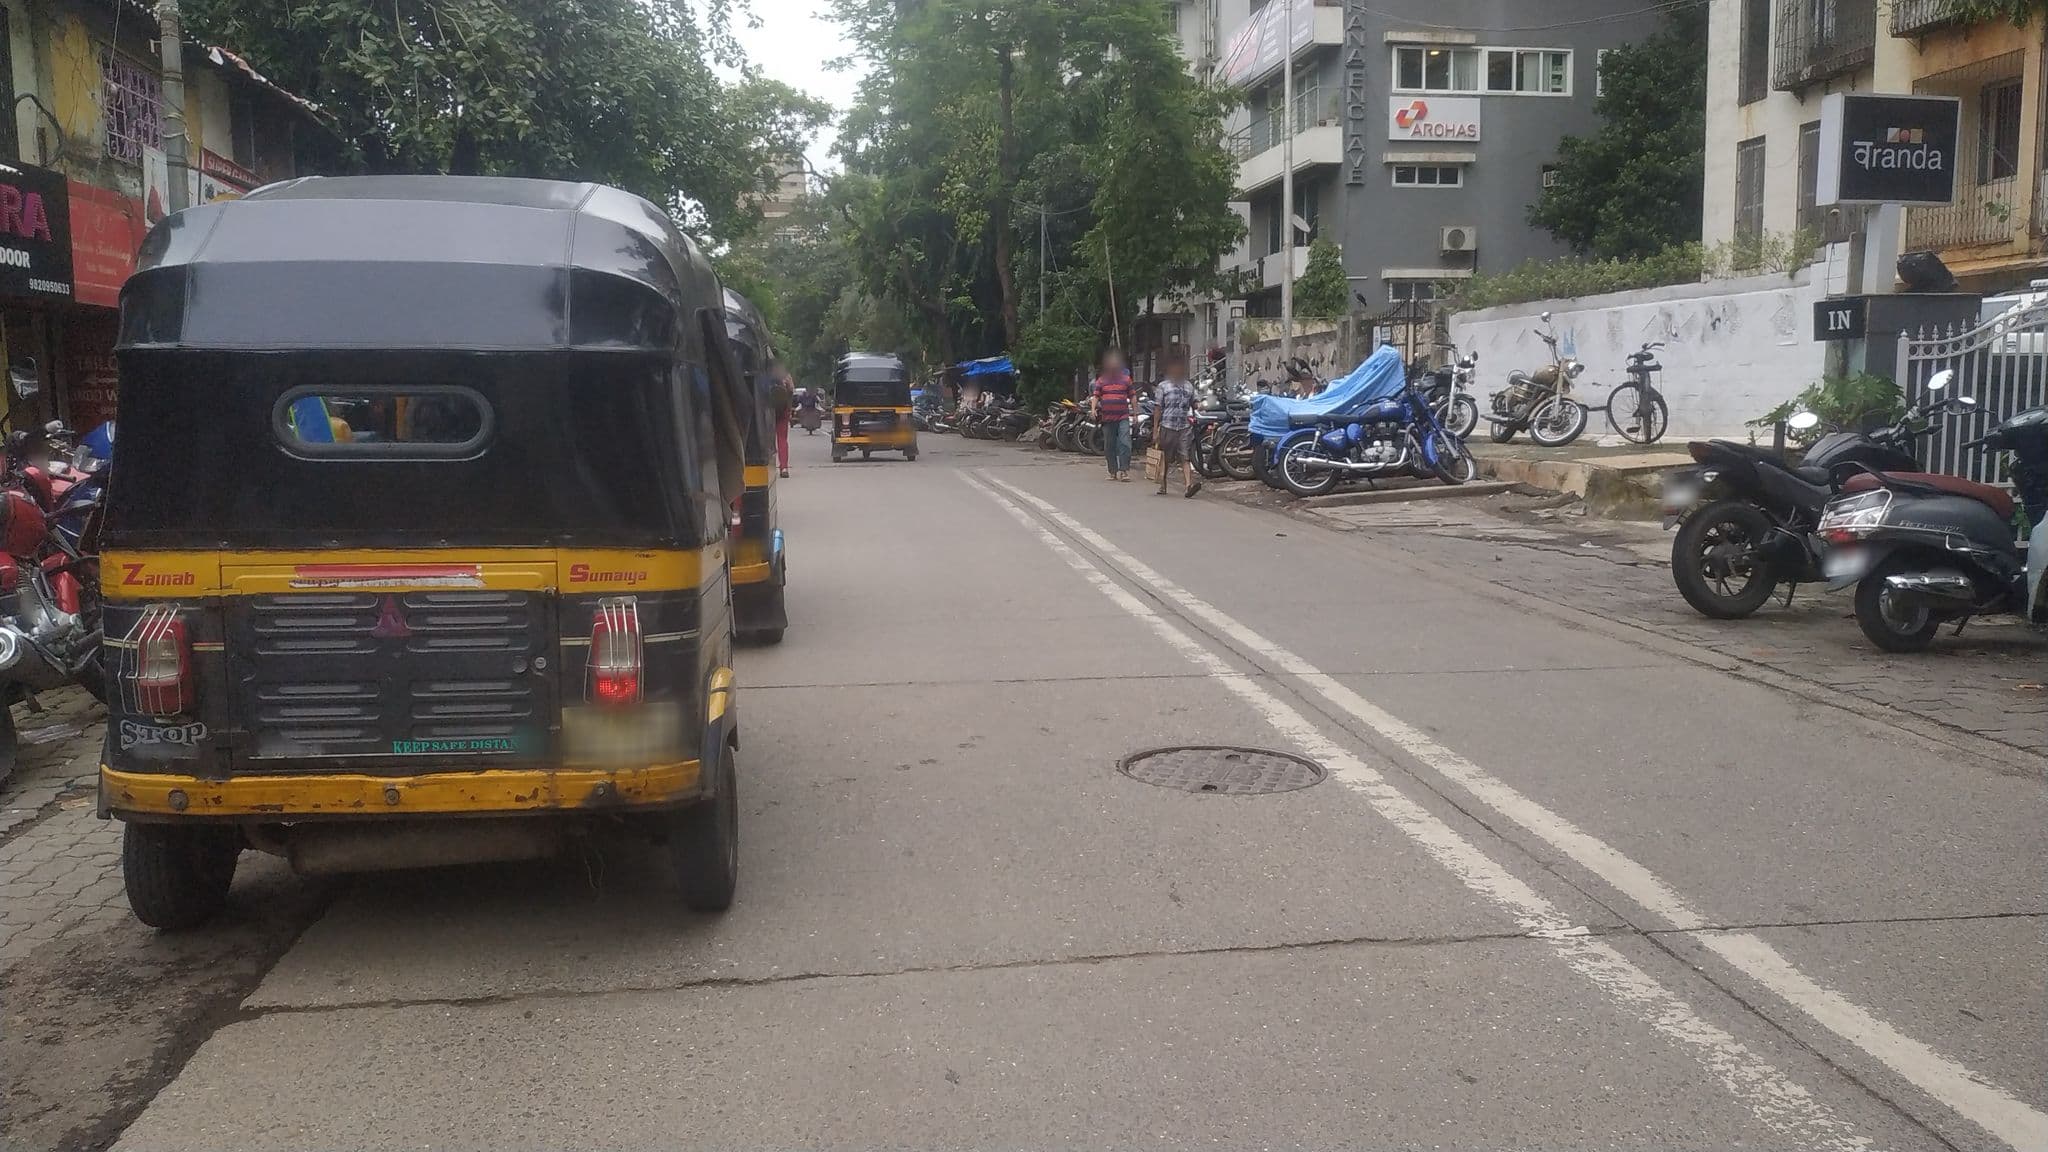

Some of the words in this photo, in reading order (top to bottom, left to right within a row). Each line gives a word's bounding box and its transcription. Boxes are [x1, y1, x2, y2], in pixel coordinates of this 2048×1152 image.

[1346, 72, 1366, 185] ENCLAVE
[1410, 122, 1477, 138] AROHAS
[29, 278, 70, 296] 9820950633
[1828, 310, 1851, 331] IN
[121, 563, 194, 586] Zainab
[569, 564, 648, 585] Sumaiya
[120, 719, 208, 751] STOP
[392, 740, 430, 754] KEEP
[431, 740, 467, 751] SAFE
